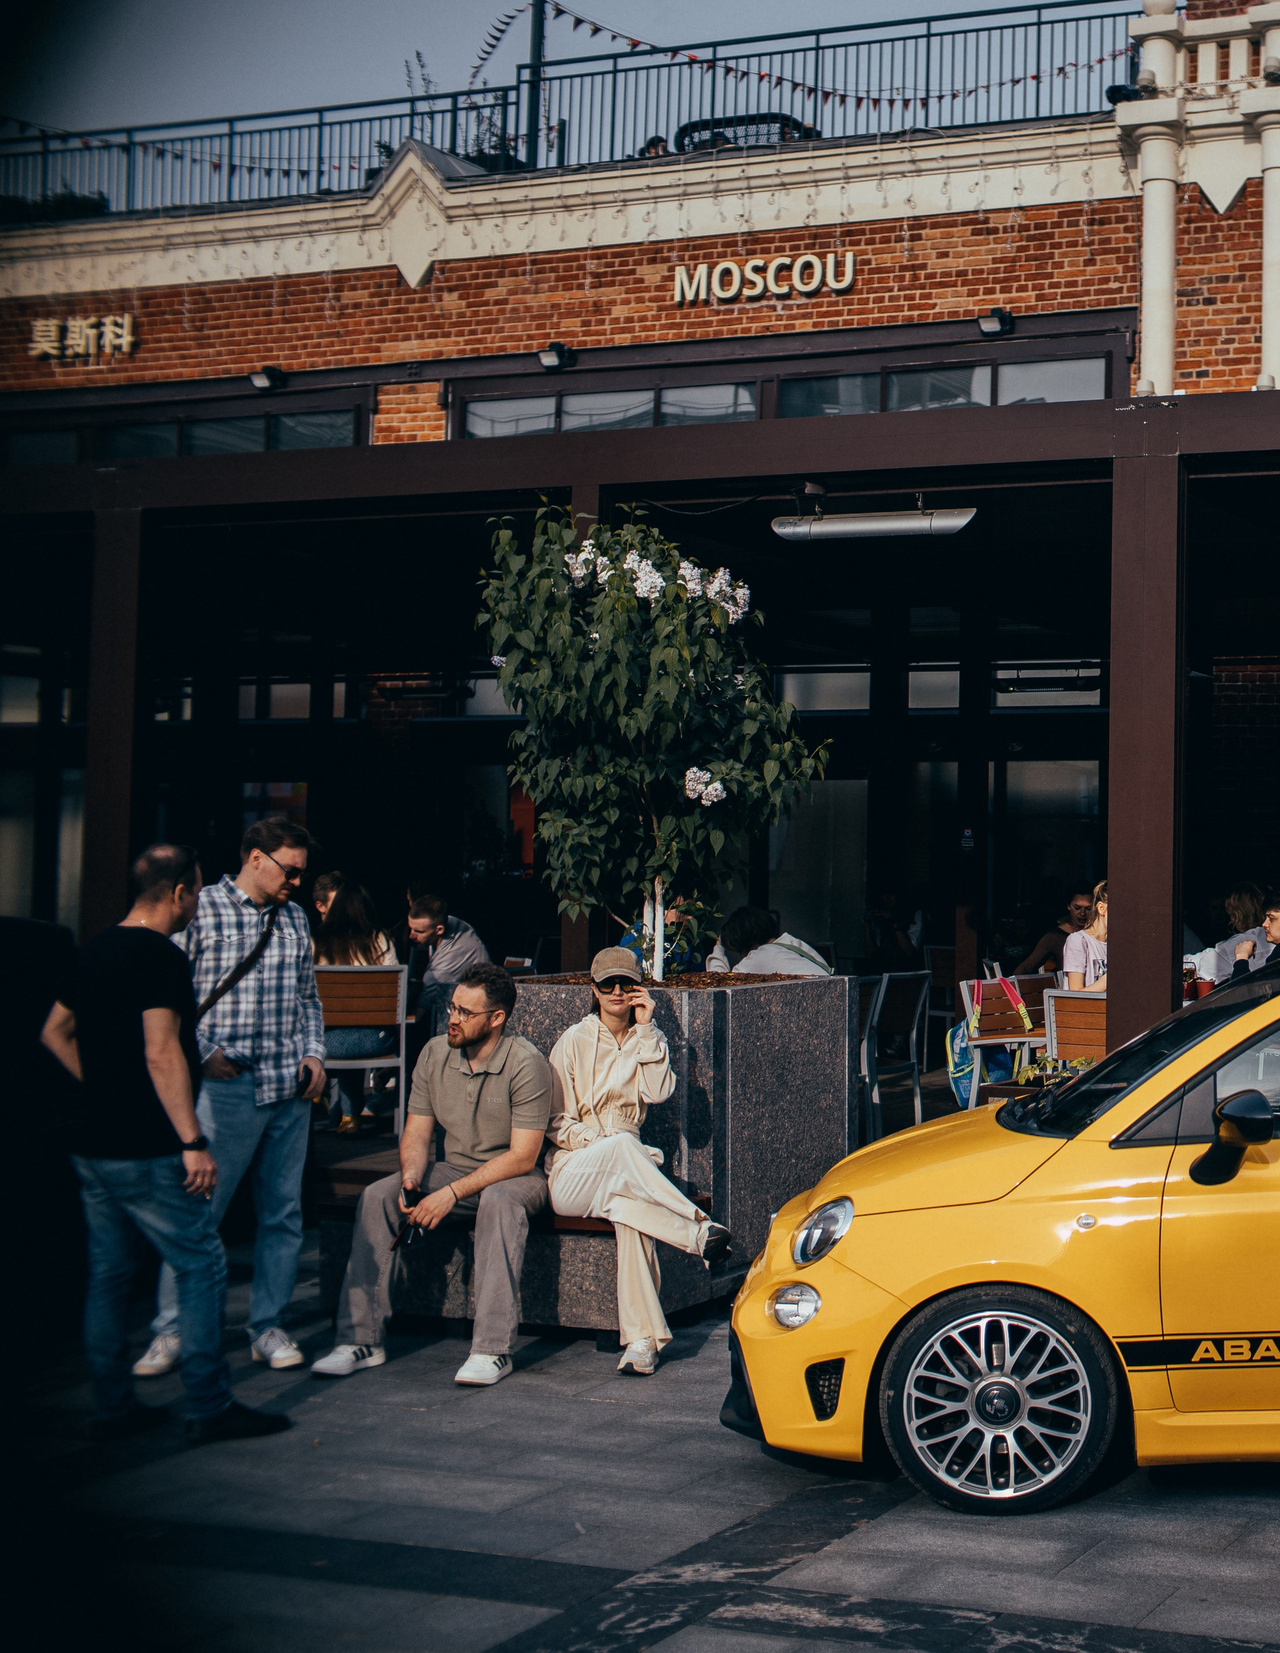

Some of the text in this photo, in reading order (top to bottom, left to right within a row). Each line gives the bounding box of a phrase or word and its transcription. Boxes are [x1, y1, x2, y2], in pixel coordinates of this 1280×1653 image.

[673, 251, 856, 306] MOSCOU
[28, 312, 137, 358] 莫斯科
